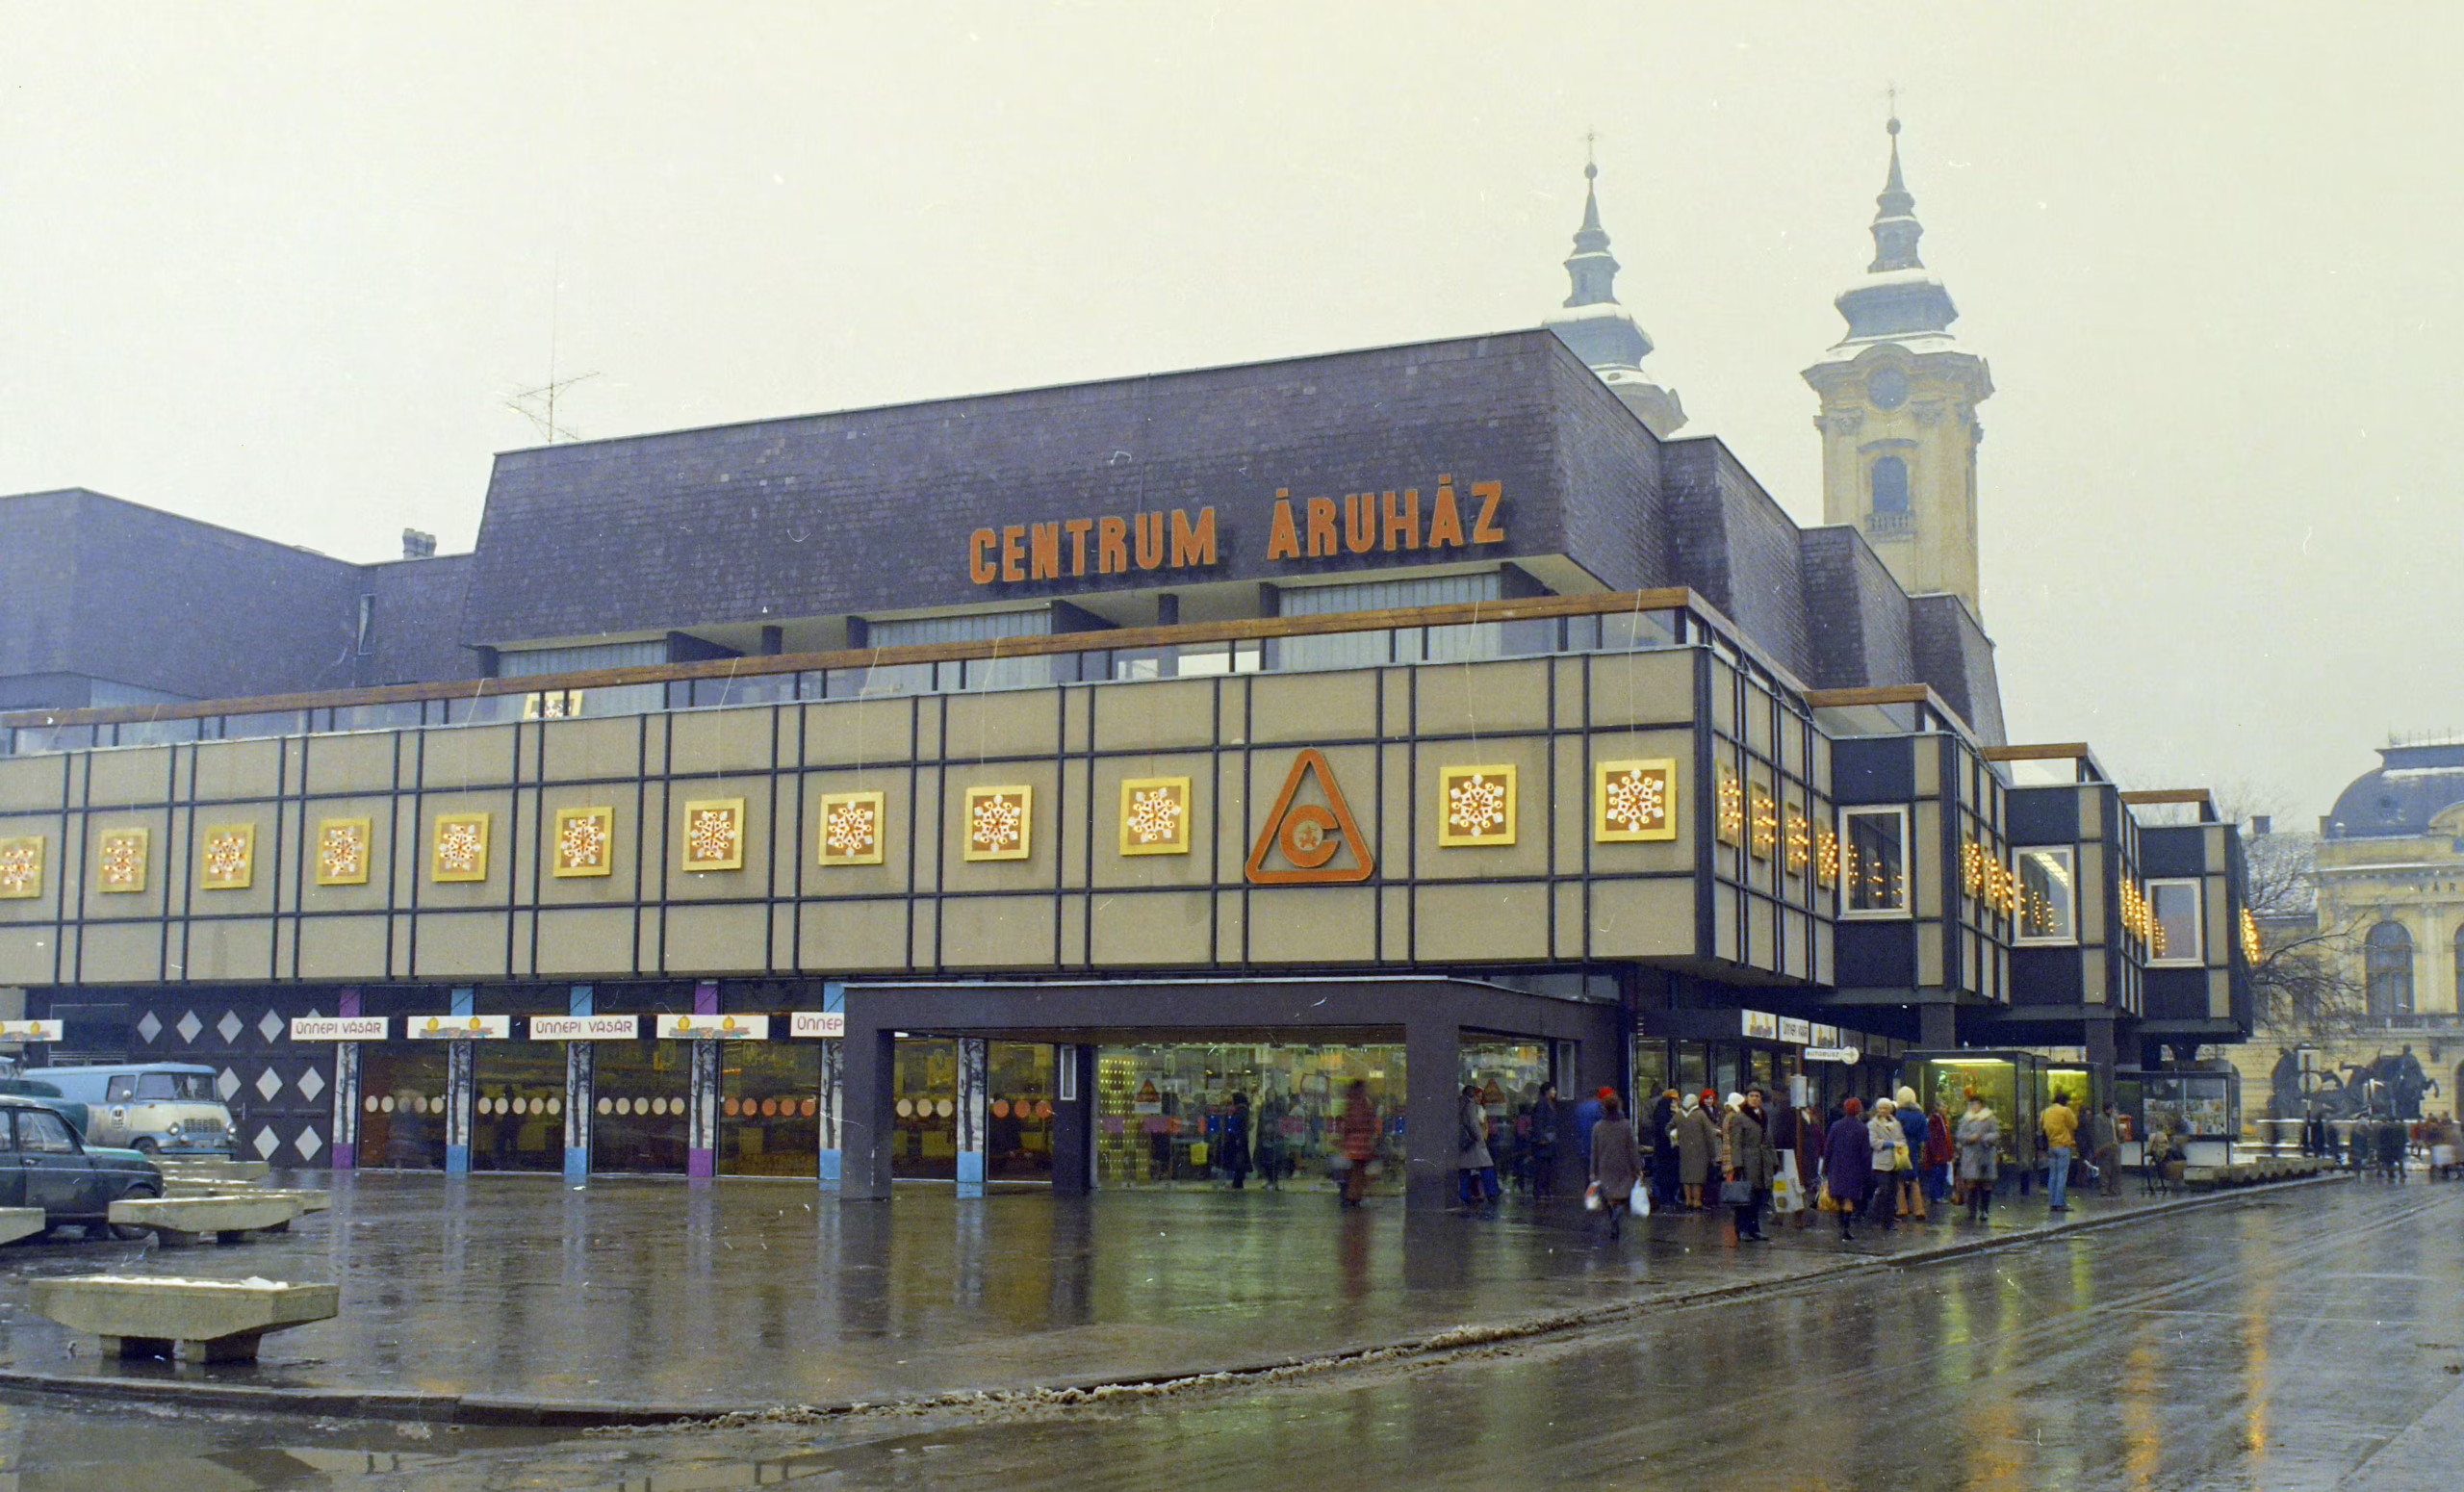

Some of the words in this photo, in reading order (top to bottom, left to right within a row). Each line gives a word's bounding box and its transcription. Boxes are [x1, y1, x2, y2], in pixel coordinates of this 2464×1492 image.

[970, 506, 1216, 584] CENTRUM
[1267, 474, 1504, 560] ÁRUHÁZ
[295, 1021, 338, 1035] ÜNNEPI
[342, 1021, 382, 1034] VÁSÁR
[535, 1020, 581, 1034] ÜNNEPI
[588, 1019, 632, 1033] VÁSÁR
